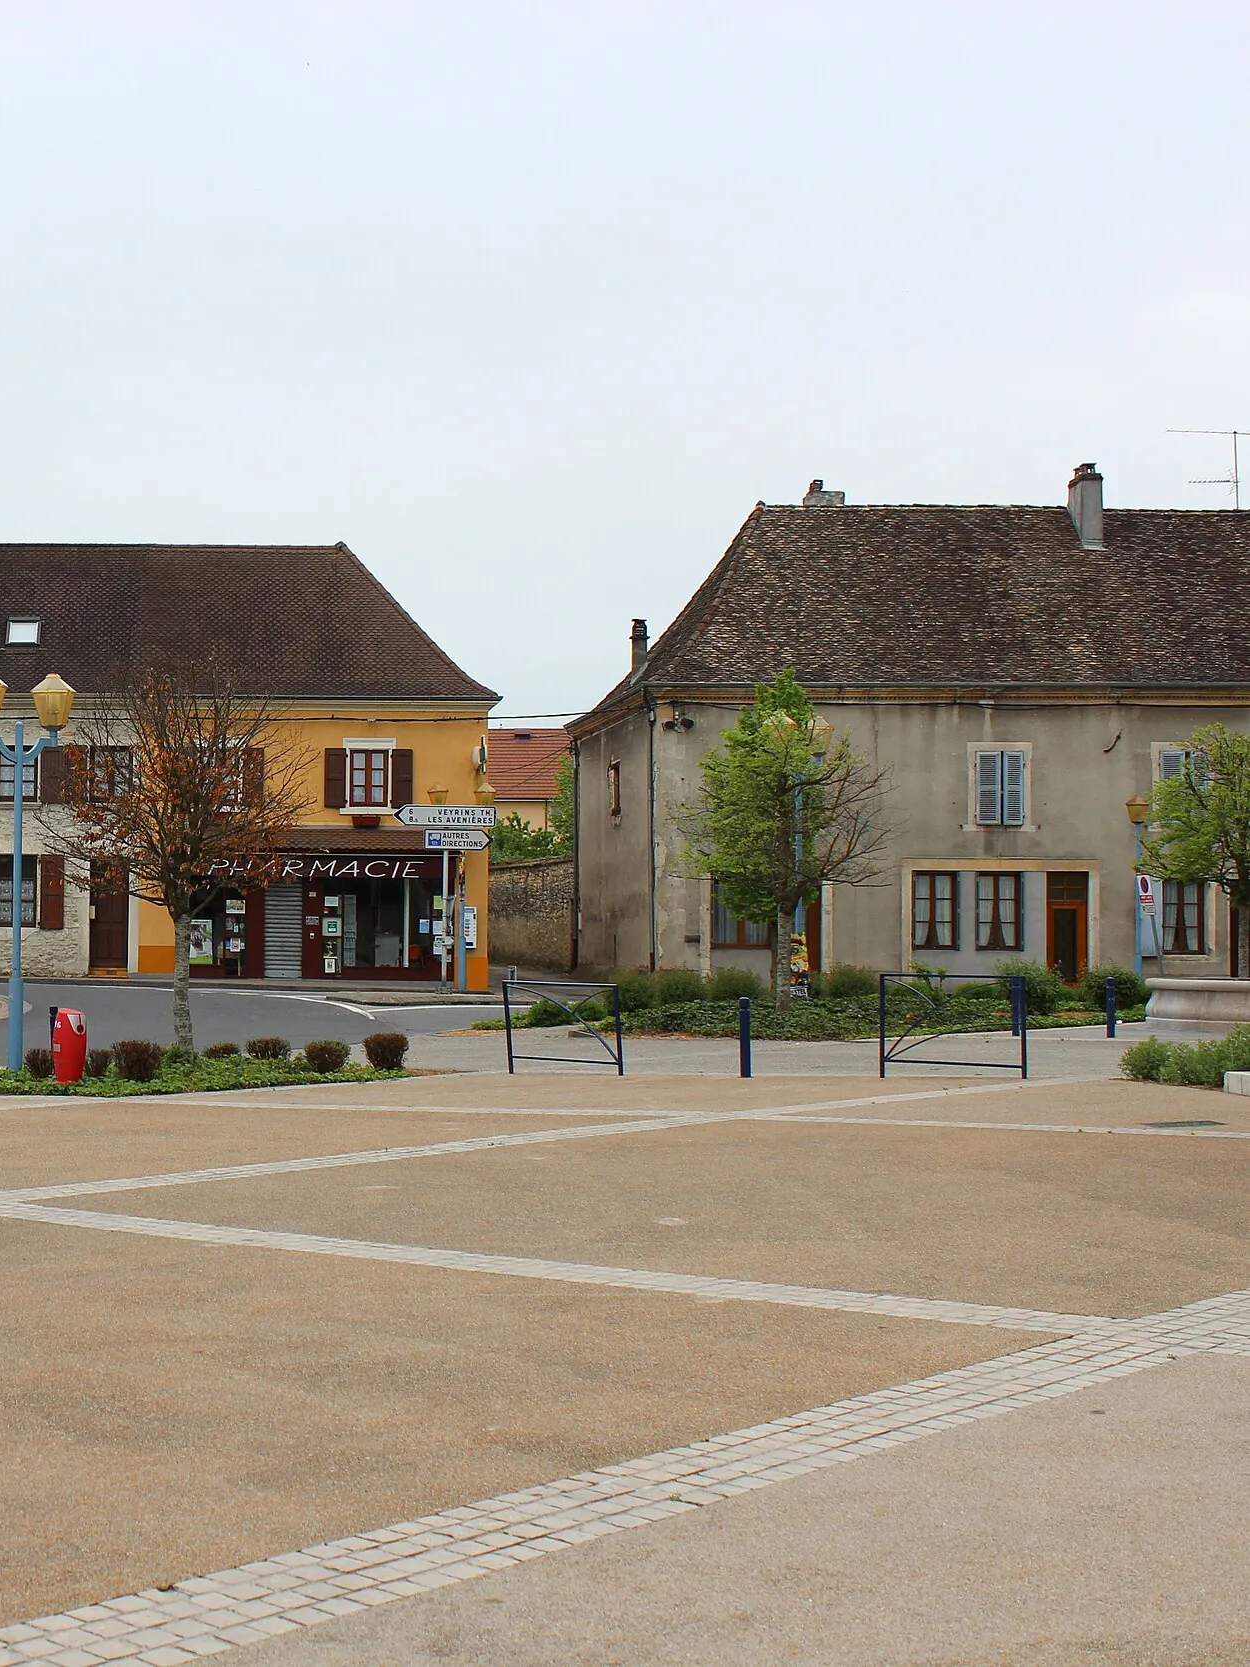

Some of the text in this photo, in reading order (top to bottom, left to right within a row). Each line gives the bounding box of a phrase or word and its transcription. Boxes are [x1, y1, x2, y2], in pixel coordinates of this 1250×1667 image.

[446, 815, 493, 824] AVENIÈRES
[442, 840, 483, 848] DIRECTIONS
[206, 858, 425, 879] PHARMACIE
